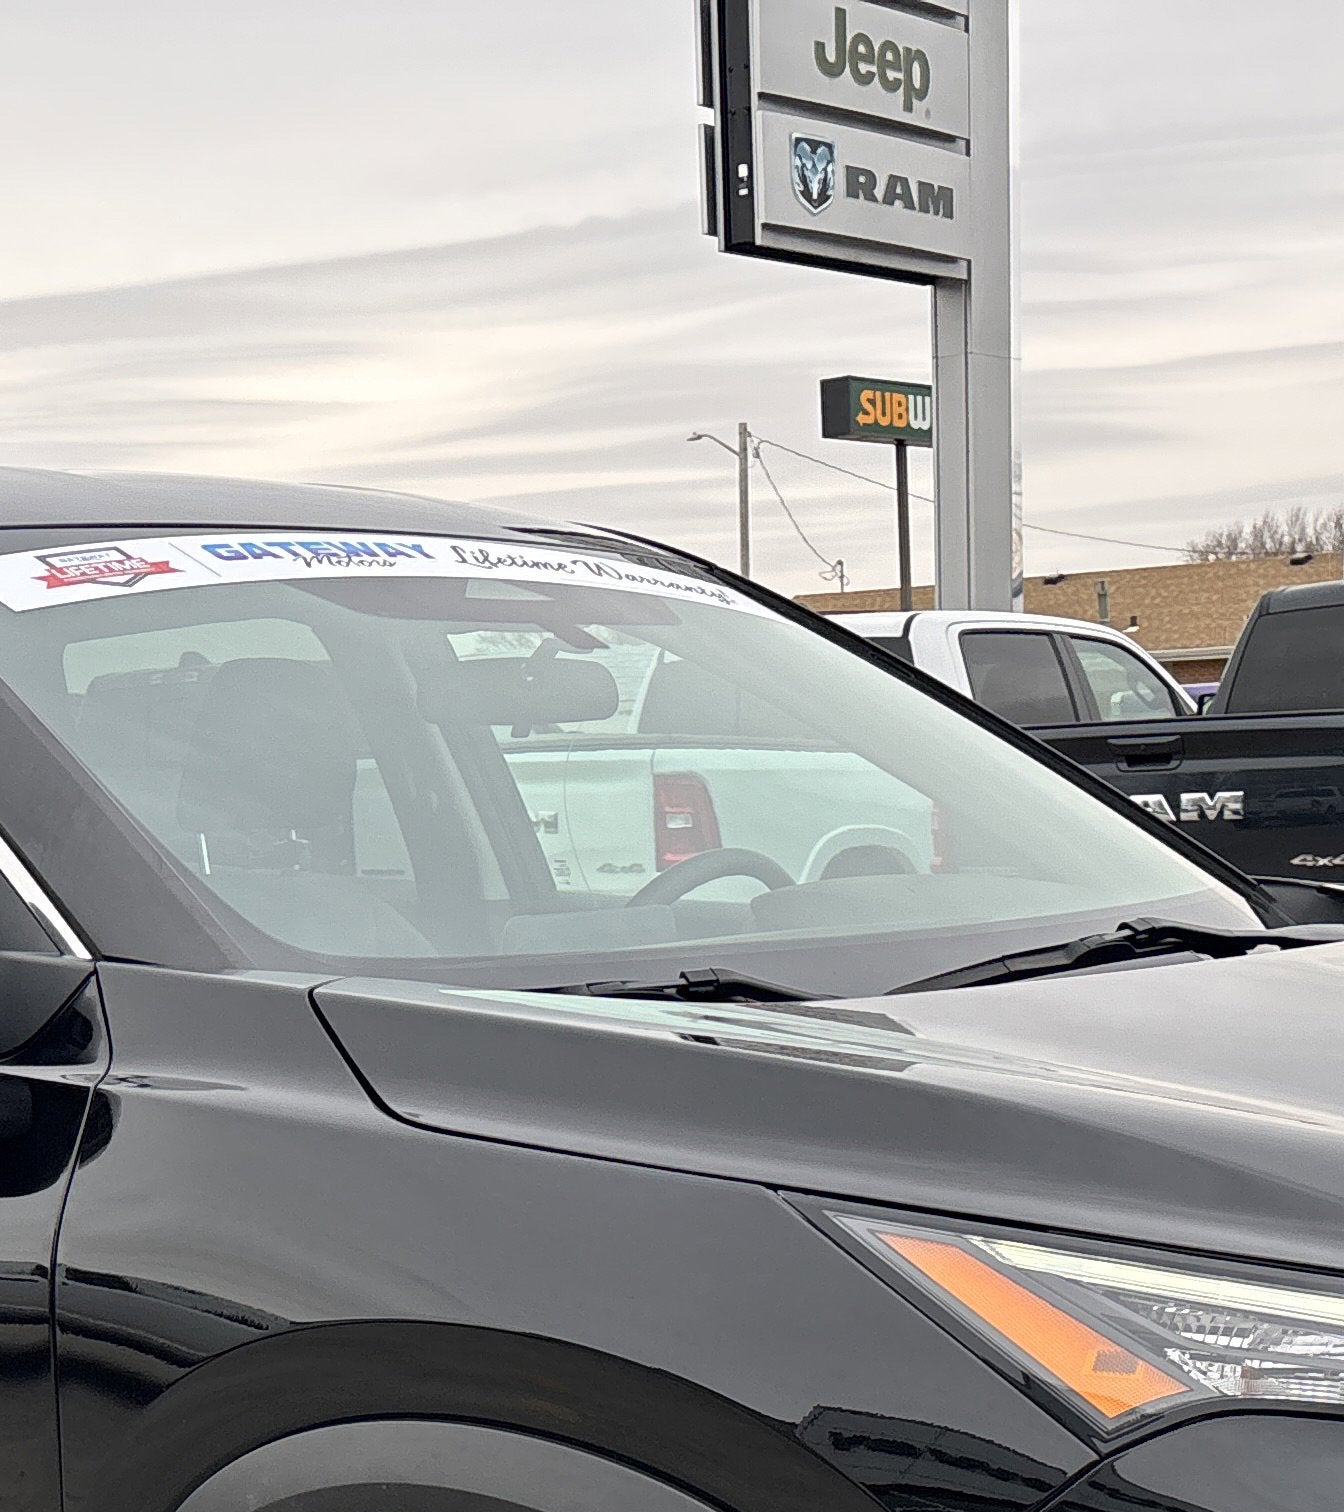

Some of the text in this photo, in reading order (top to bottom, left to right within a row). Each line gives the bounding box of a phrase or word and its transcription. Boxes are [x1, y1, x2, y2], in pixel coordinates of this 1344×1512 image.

[814, 6, 931, 113] Jeep
[845, 164, 954, 220] RAM
[856, 389, 931, 430] SUBW
[201, 541, 436, 561] GATEWAY
[450, 545, 575, 575] Lifetime
[51, 558, 150, 579] LIFETIME
[1130, 791, 1245, 822] AM
